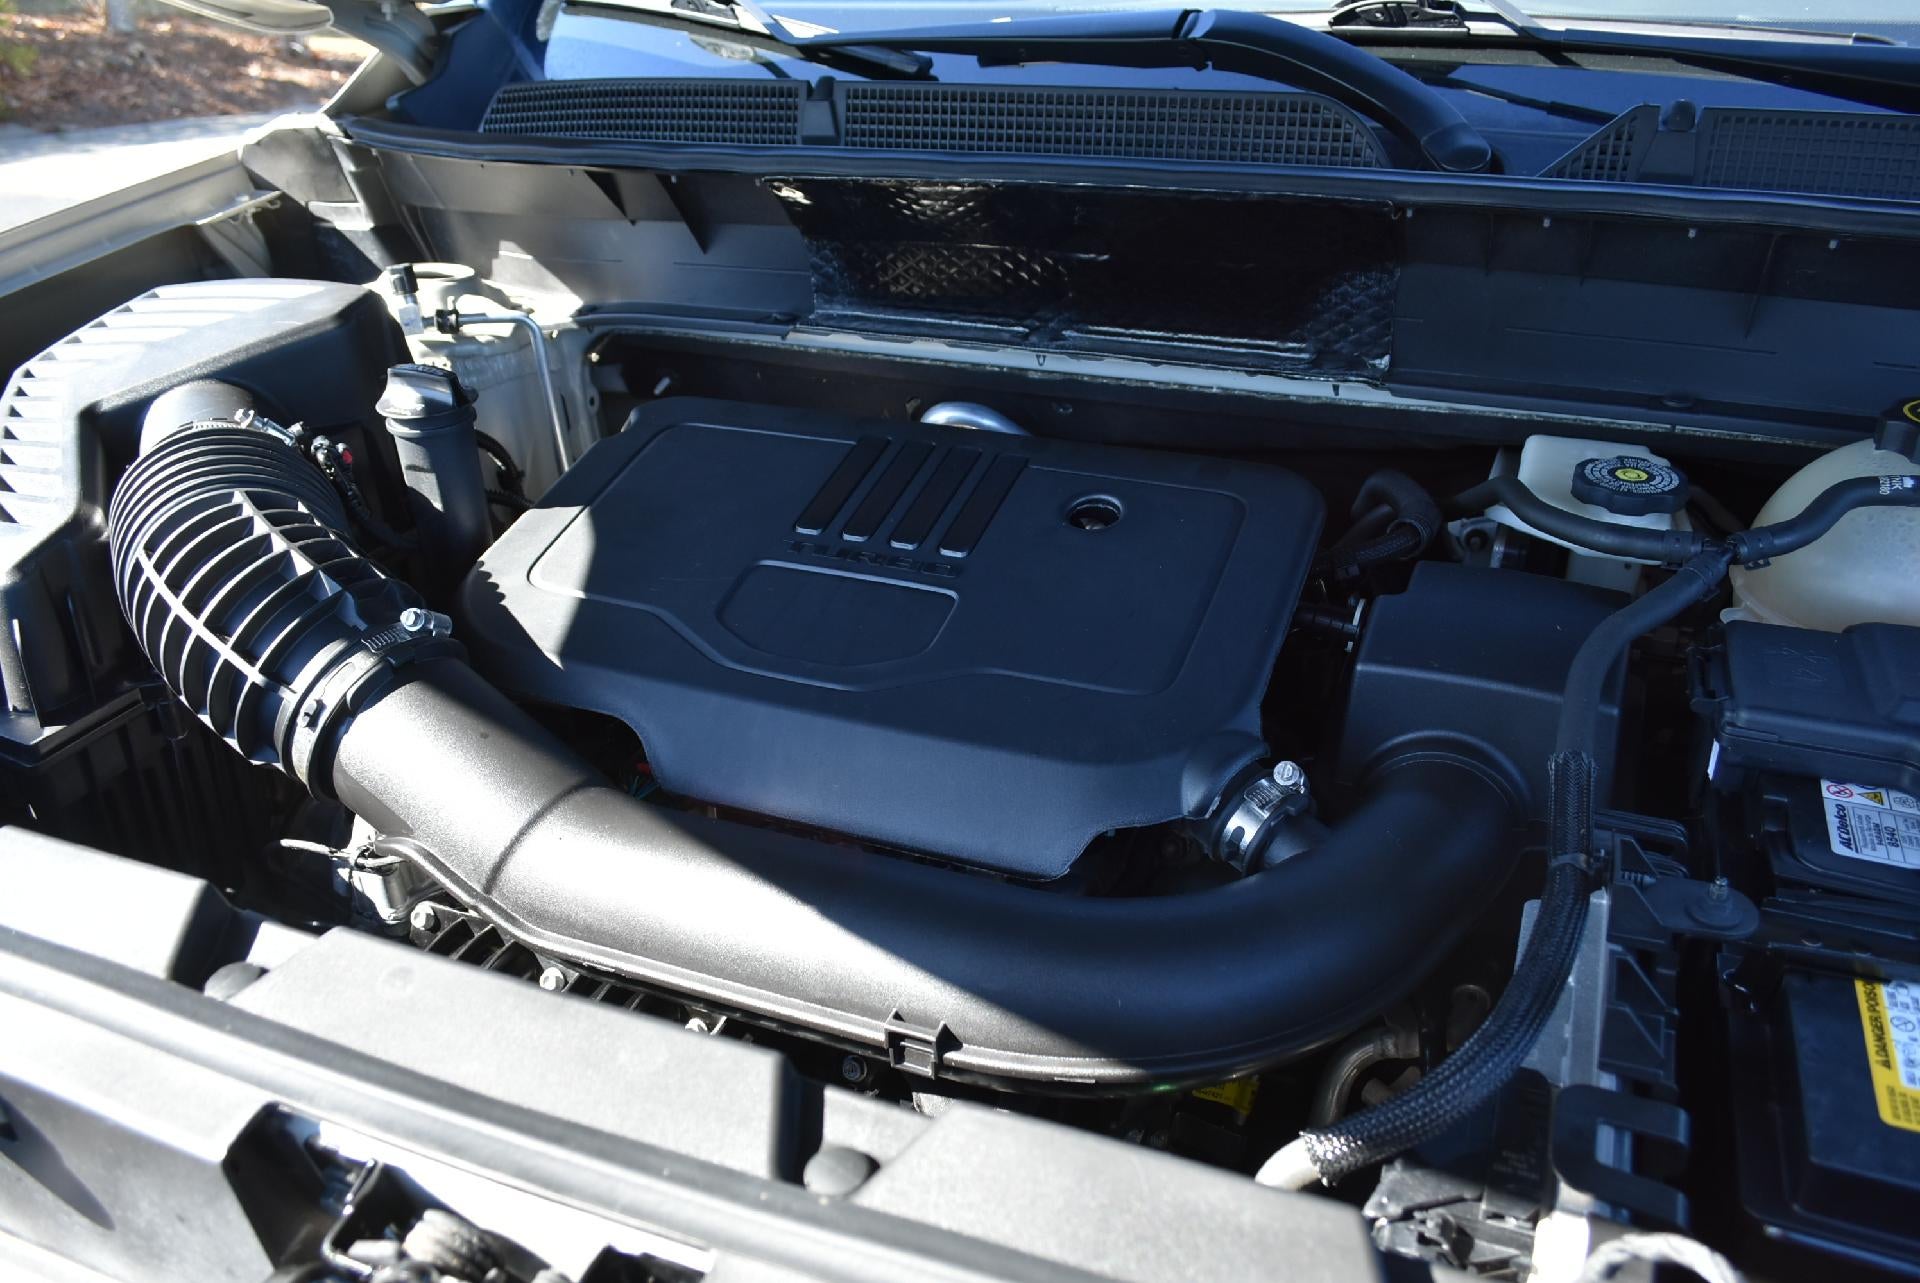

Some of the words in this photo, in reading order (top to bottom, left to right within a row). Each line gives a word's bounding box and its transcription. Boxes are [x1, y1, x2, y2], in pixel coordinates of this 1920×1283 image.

[784, 539, 963, 578] TURBO
[1834, 804, 1853, 851] ACDelco
[1863, 980, 1881, 1012] POISO
[1869, 1015, 1888, 1058] DANGER
